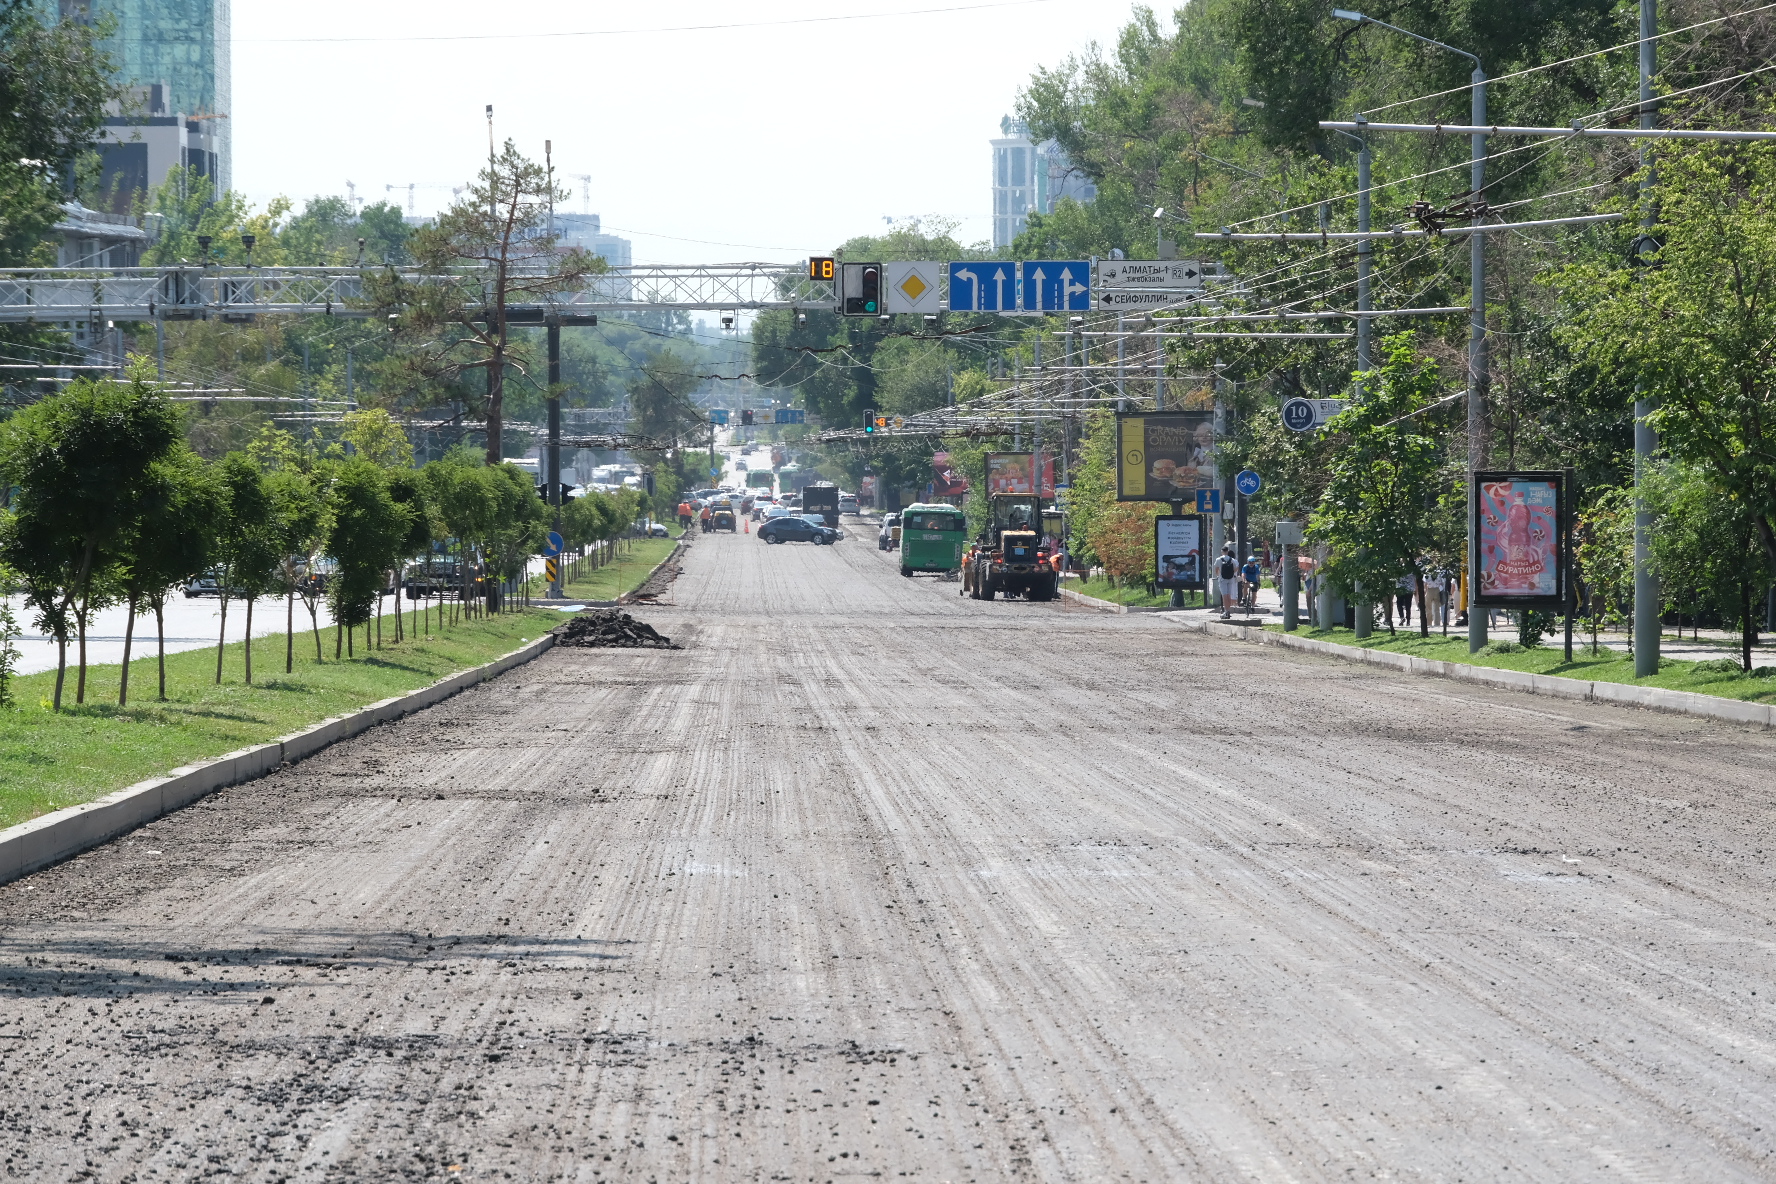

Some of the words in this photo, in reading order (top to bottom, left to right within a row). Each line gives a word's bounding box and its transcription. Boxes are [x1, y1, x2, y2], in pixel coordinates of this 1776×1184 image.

[811, 260, 833, 278] 18
[1173, 269, 1182, 278] R2
[1290, 405, 1308, 418] 10
[874, 417, 886, 427] 48
[1148, 426, 1188, 435] GRAND
[1497, 563, 1542, 574] БУРАТИНО
